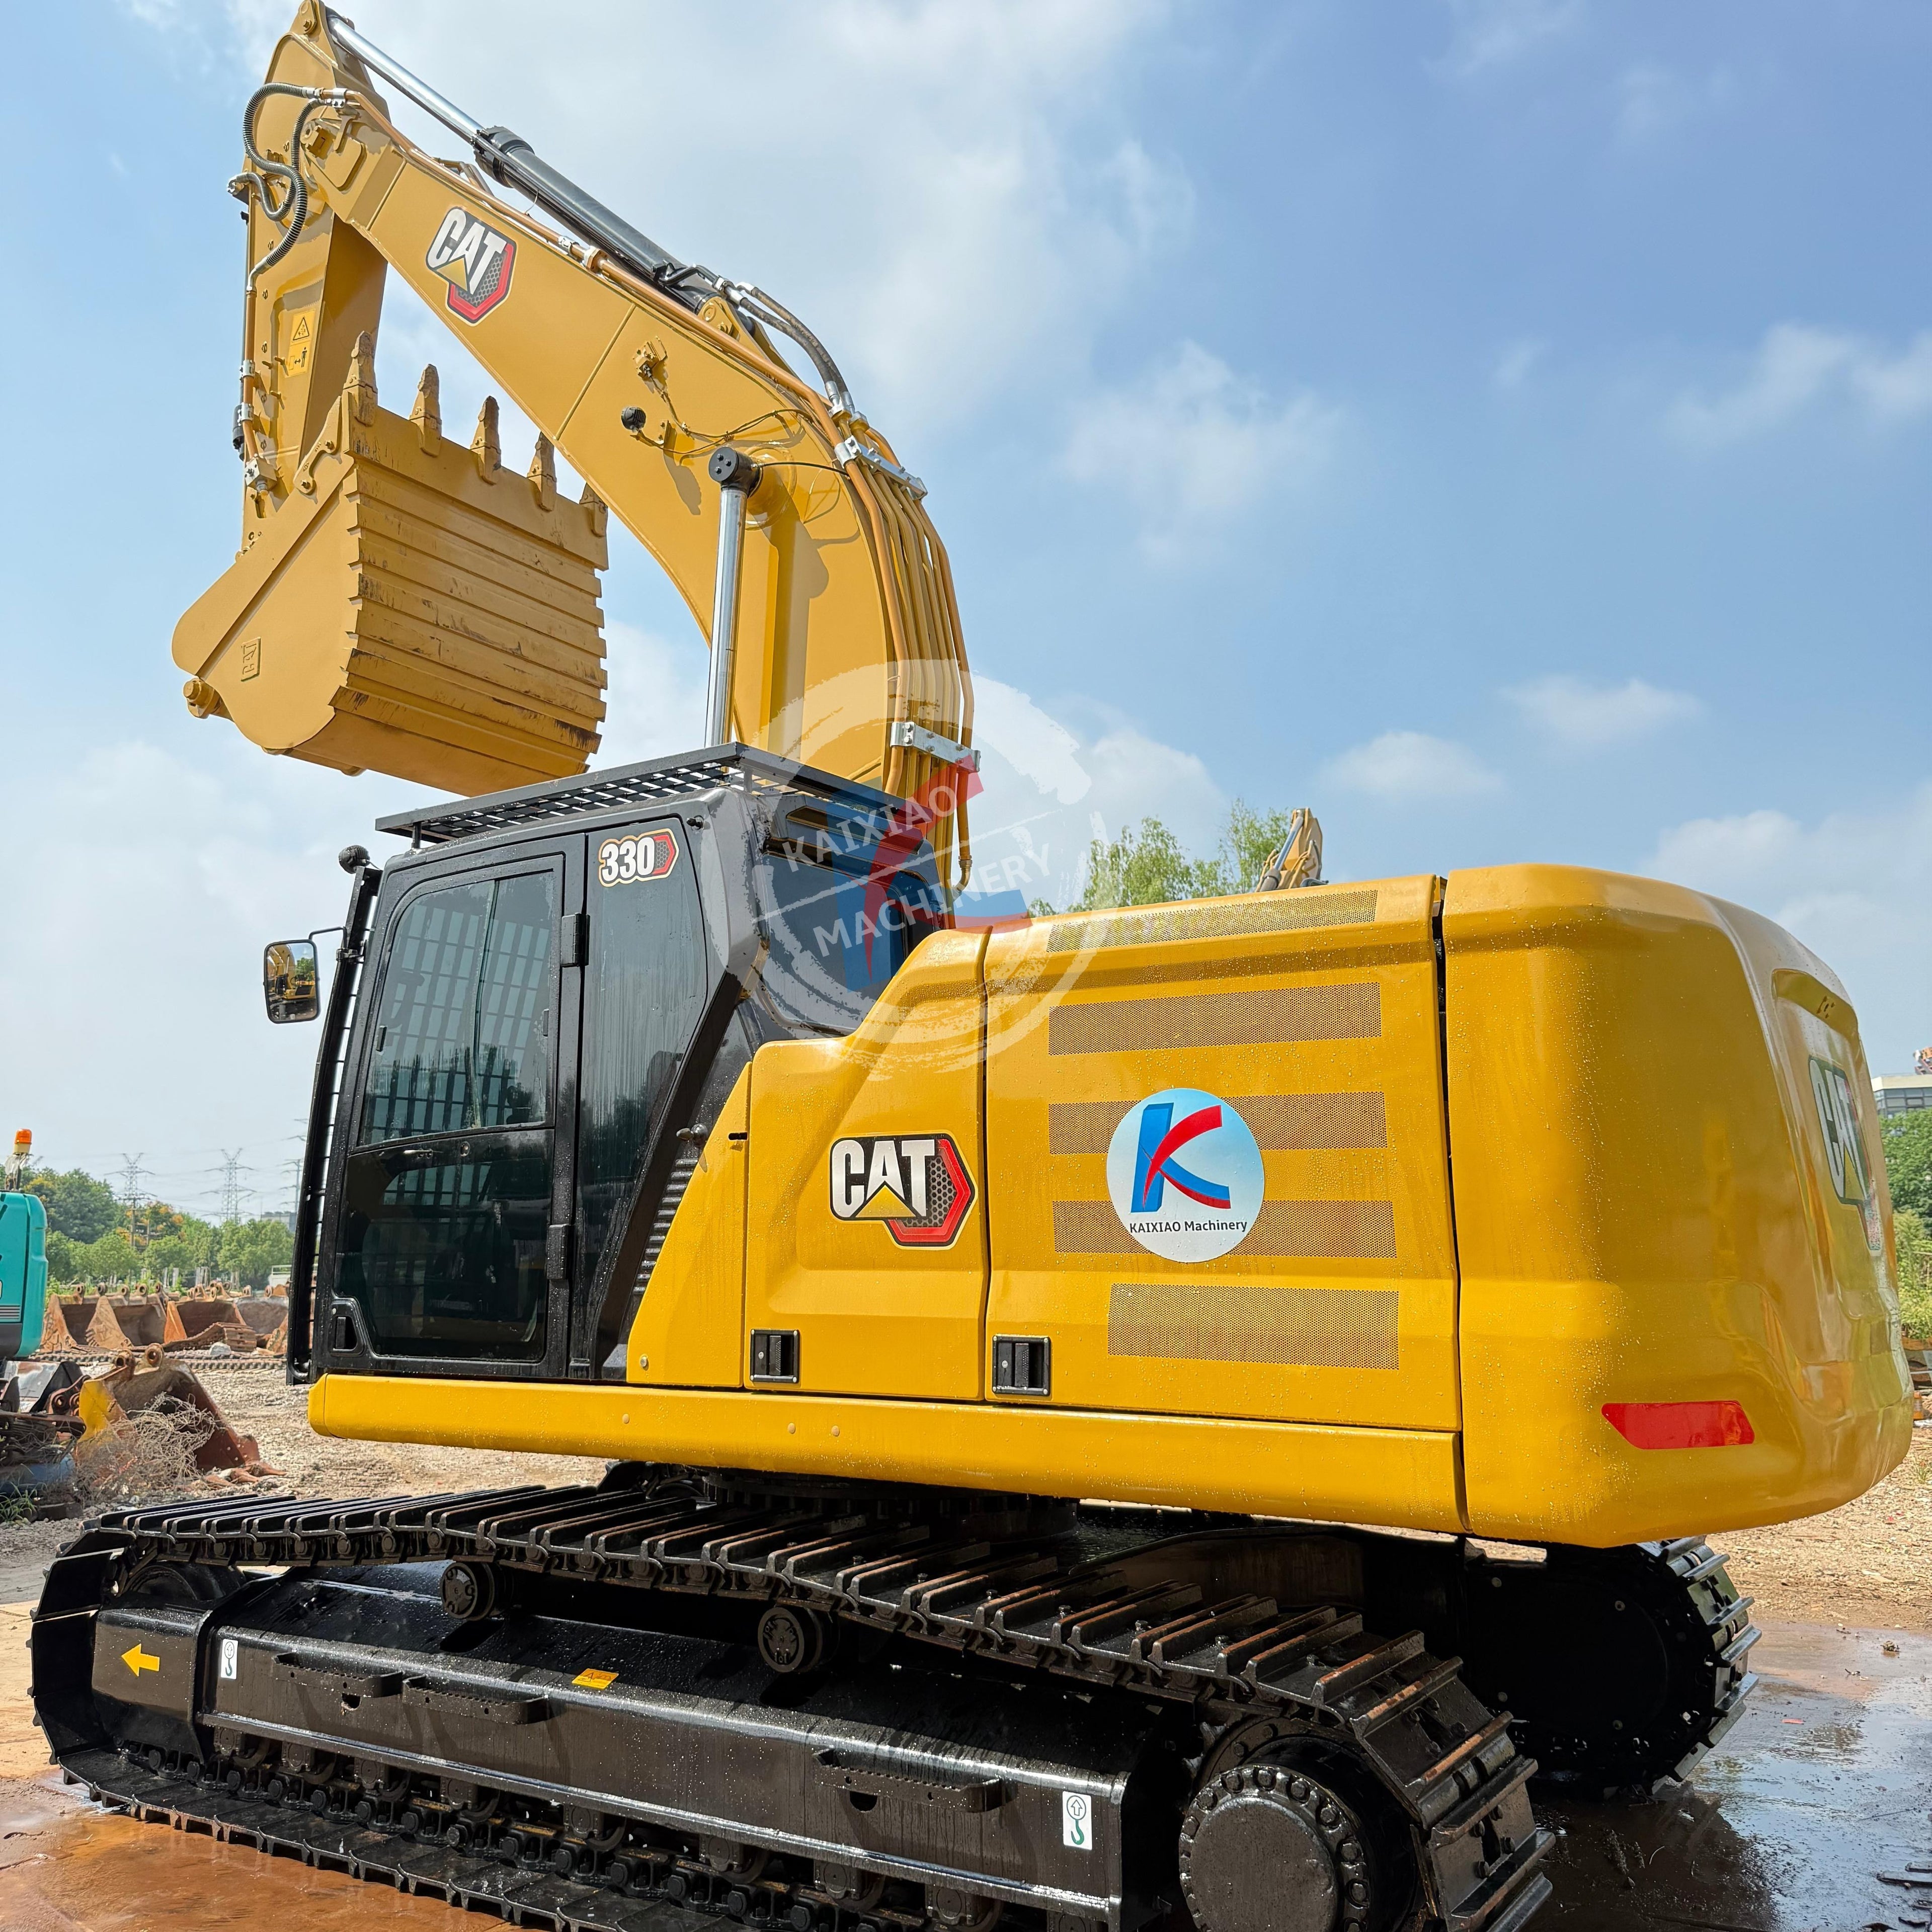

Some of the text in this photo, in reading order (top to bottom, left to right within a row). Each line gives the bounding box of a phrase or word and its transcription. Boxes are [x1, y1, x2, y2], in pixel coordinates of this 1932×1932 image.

[428, 208, 507, 295] CAT
[241, 643, 257, 675] CAT
[602, 837, 655, 881] 330
[1810, 1060, 1868, 1200] CAT
[832, 1140, 935, 1218] CAT
[1130, 1220, 1247, 1233] KAIXIAO Machinery
